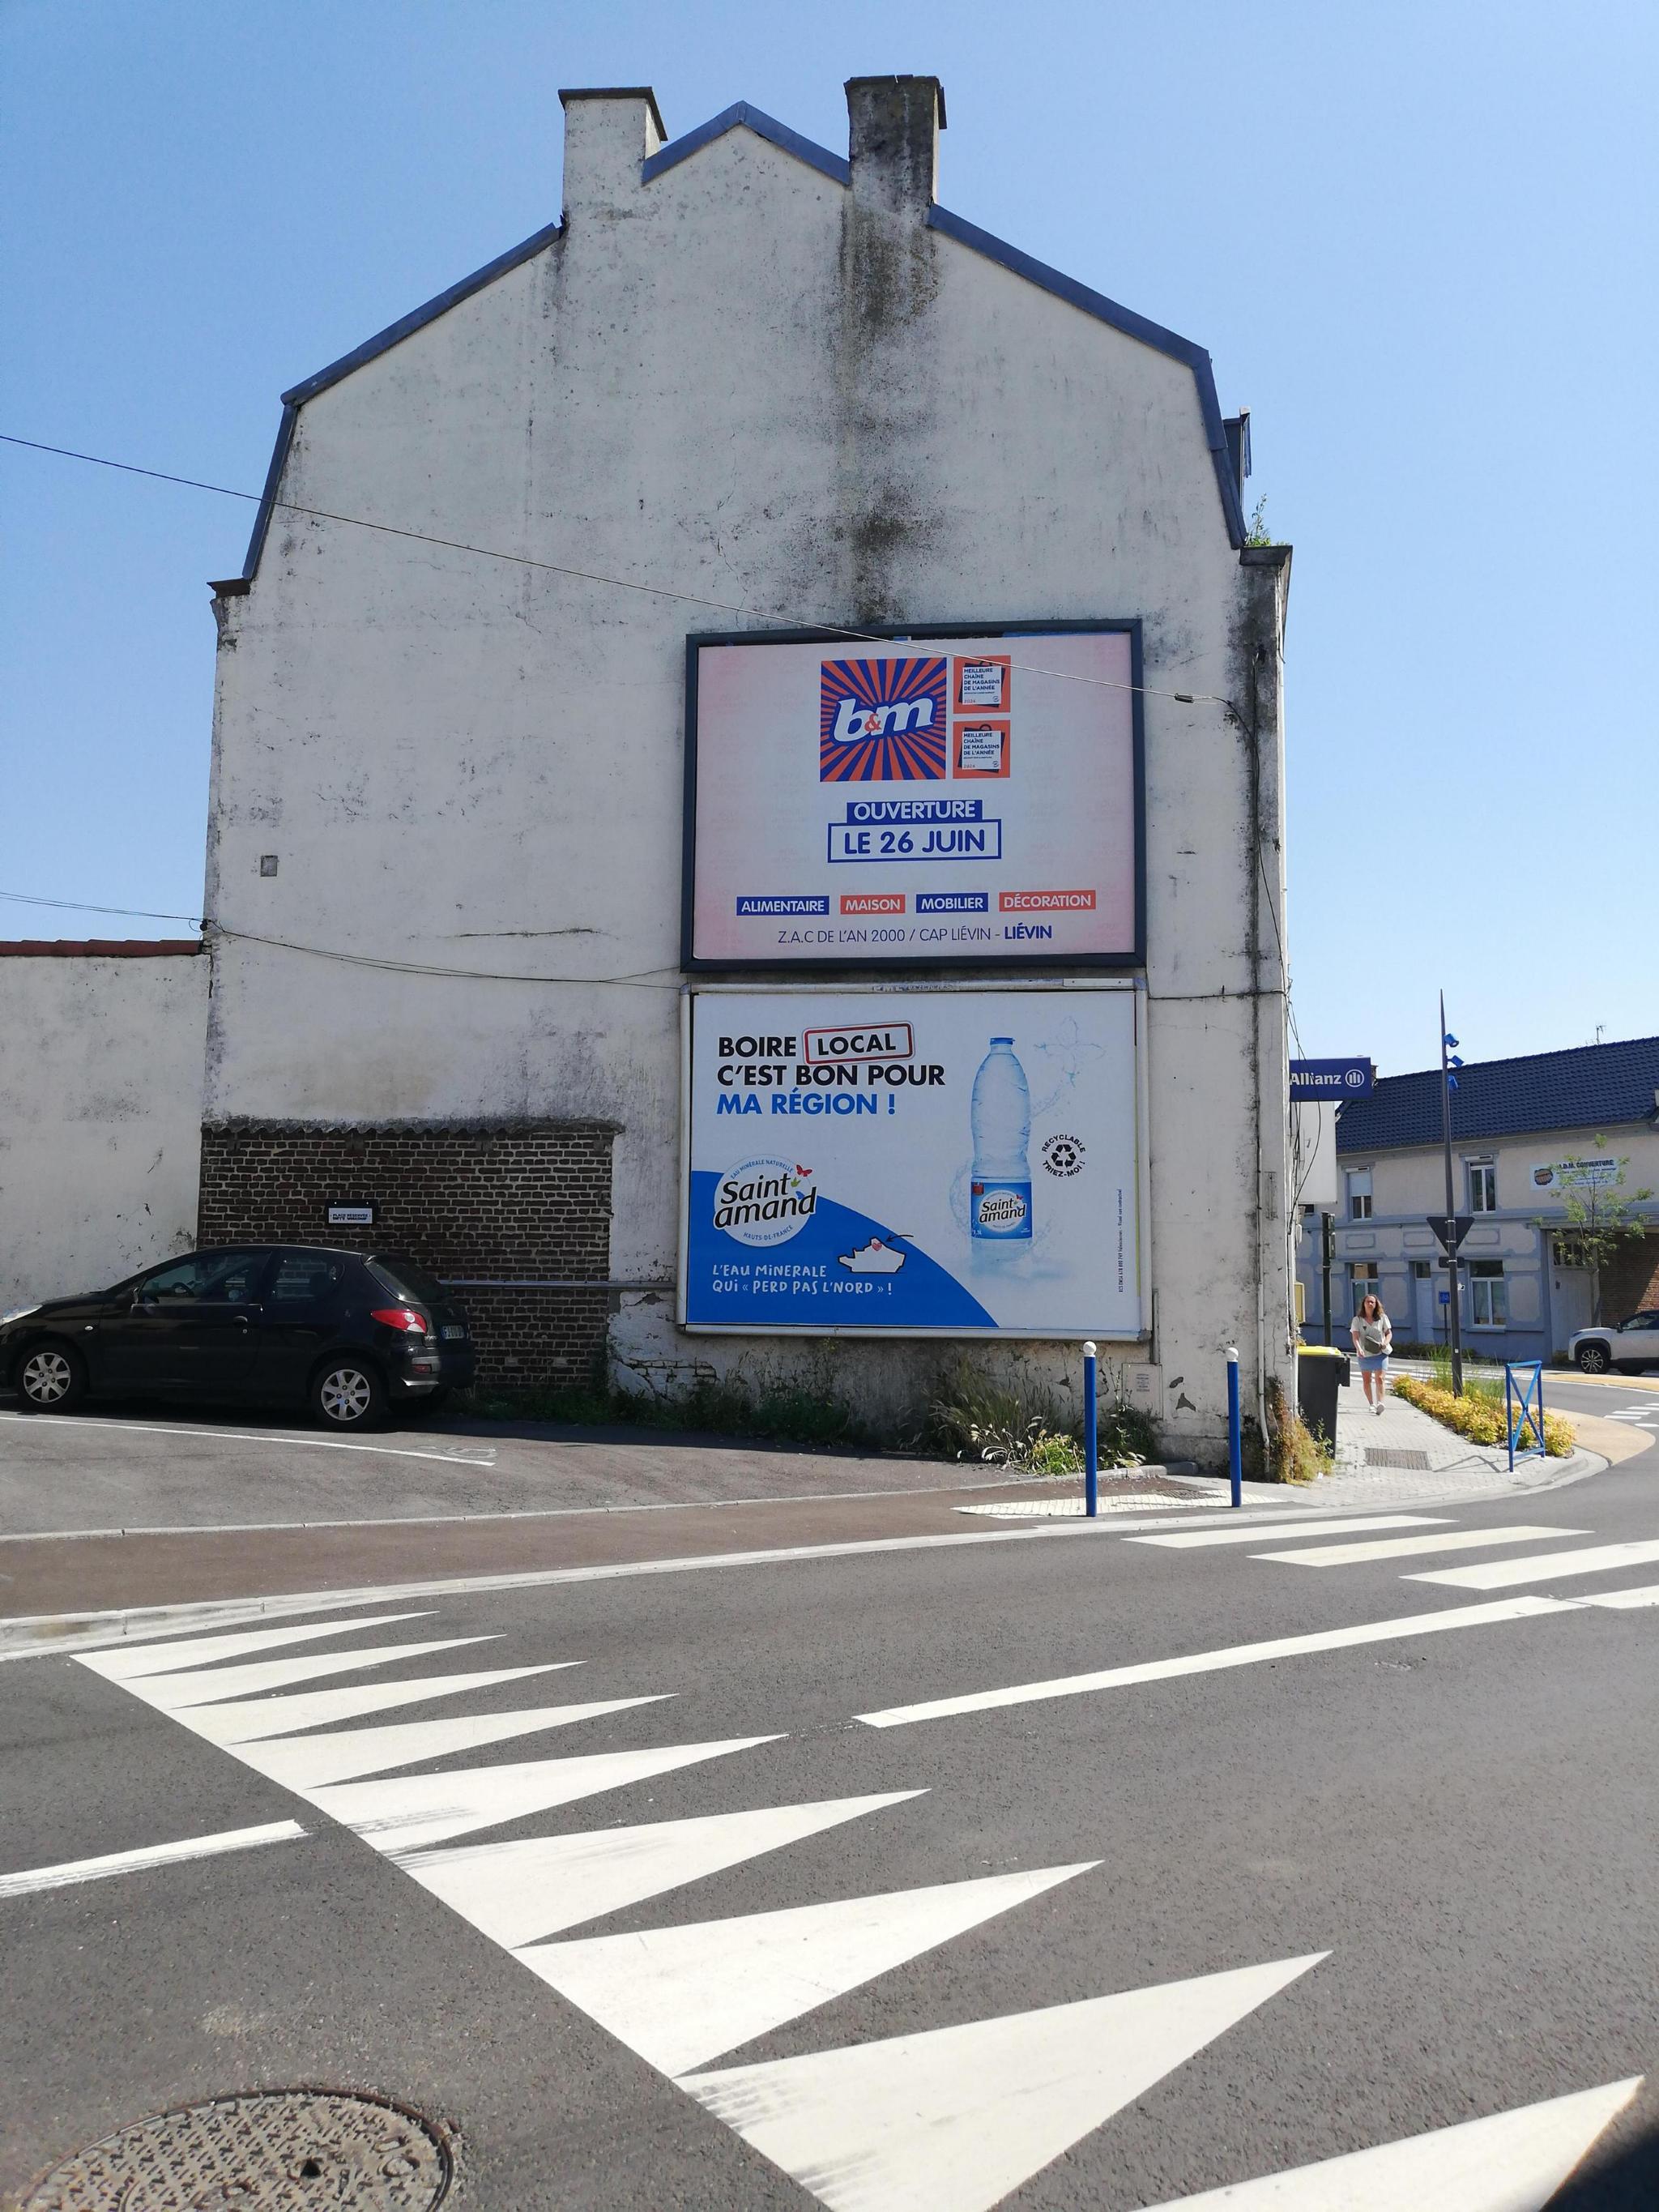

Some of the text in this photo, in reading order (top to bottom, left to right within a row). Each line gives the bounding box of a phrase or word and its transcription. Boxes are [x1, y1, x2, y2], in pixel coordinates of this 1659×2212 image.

[834, 698, 934, 742] b&m
[854, 800, 976, 821] OUVERTURE
[844, 829, 985, 855] LE 26 JUIN
[741, 900, 825, 913] ALIMENTAIRE
[845, 899, 901, 912] MAISON
[921, 897, 983, 910] MOBILIER
[1004, 893, 1091, 908] DÉCORATION
[817, 930, 834, 943] DE
[839, 930, 867, 942] L'AN
[871, 929, 906, 942] 2000
[919, 928, 947, 942] CAP
[951, 925, 991, 941] LIÉVIN
[1004, 922, 1052, 940] LIÉVIN
[719, 1033, 897, 1057] BOIRE LOCAL
[717, 1064, 946, 1086] C'EST BON POUR
[1290, 1072, 1342, 1086] Allianz
[716, 1087, 896, 1115] MA RÉGION !
[1042, 1134, 1086, 1153] RECYCLABLE
[766, 1159, 794, 1173] NATURELLE
[721, 1173, 791, 1204] Saint
[714, 1186, 817, 1228] amand
[979, 1204, 1026, 1223] amand
[981, 1198, 1014, 1213] Saint
[713, 1264, 751, 1277] L'EAU
[753, 1280, 788, 1294] PERD
[793, 1280, 818, 1295] PAS
[823, 1282, 873, 1294] L'NORD
